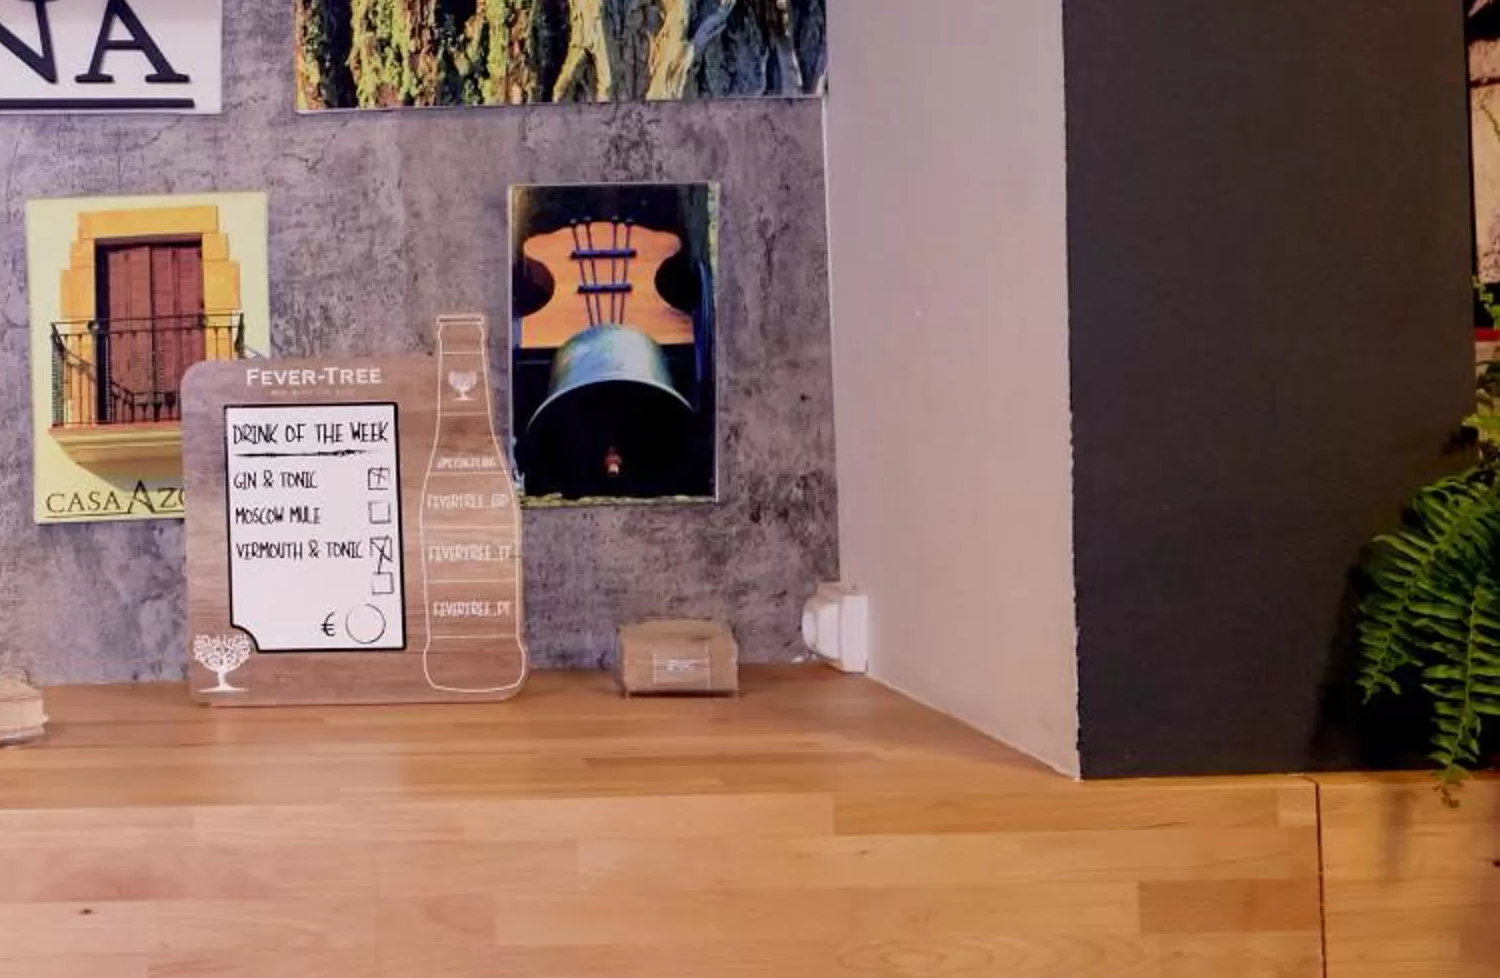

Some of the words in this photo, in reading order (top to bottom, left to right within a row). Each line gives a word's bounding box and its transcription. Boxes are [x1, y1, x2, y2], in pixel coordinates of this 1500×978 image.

[232, 423, 278, 445] DRINK
[285, 423, 306, 443] OF
[316, 423, 343, 444] THE
[350, 422, 389, 443] WEEK
[233, 471, 257, 490] GIN
[263, 469, 274, 488] &
[280, 471, 318, 489] TONIC
[45, 490, 122, 513] CASA
[235, 506, 285, 525] MOSCOW
[289, 505, 321, 525] MULE
[236, 540, 303, 561] VERMOUTH
[308, 539, 320, 559] &
[325, 540, 363, 559] TONIC
